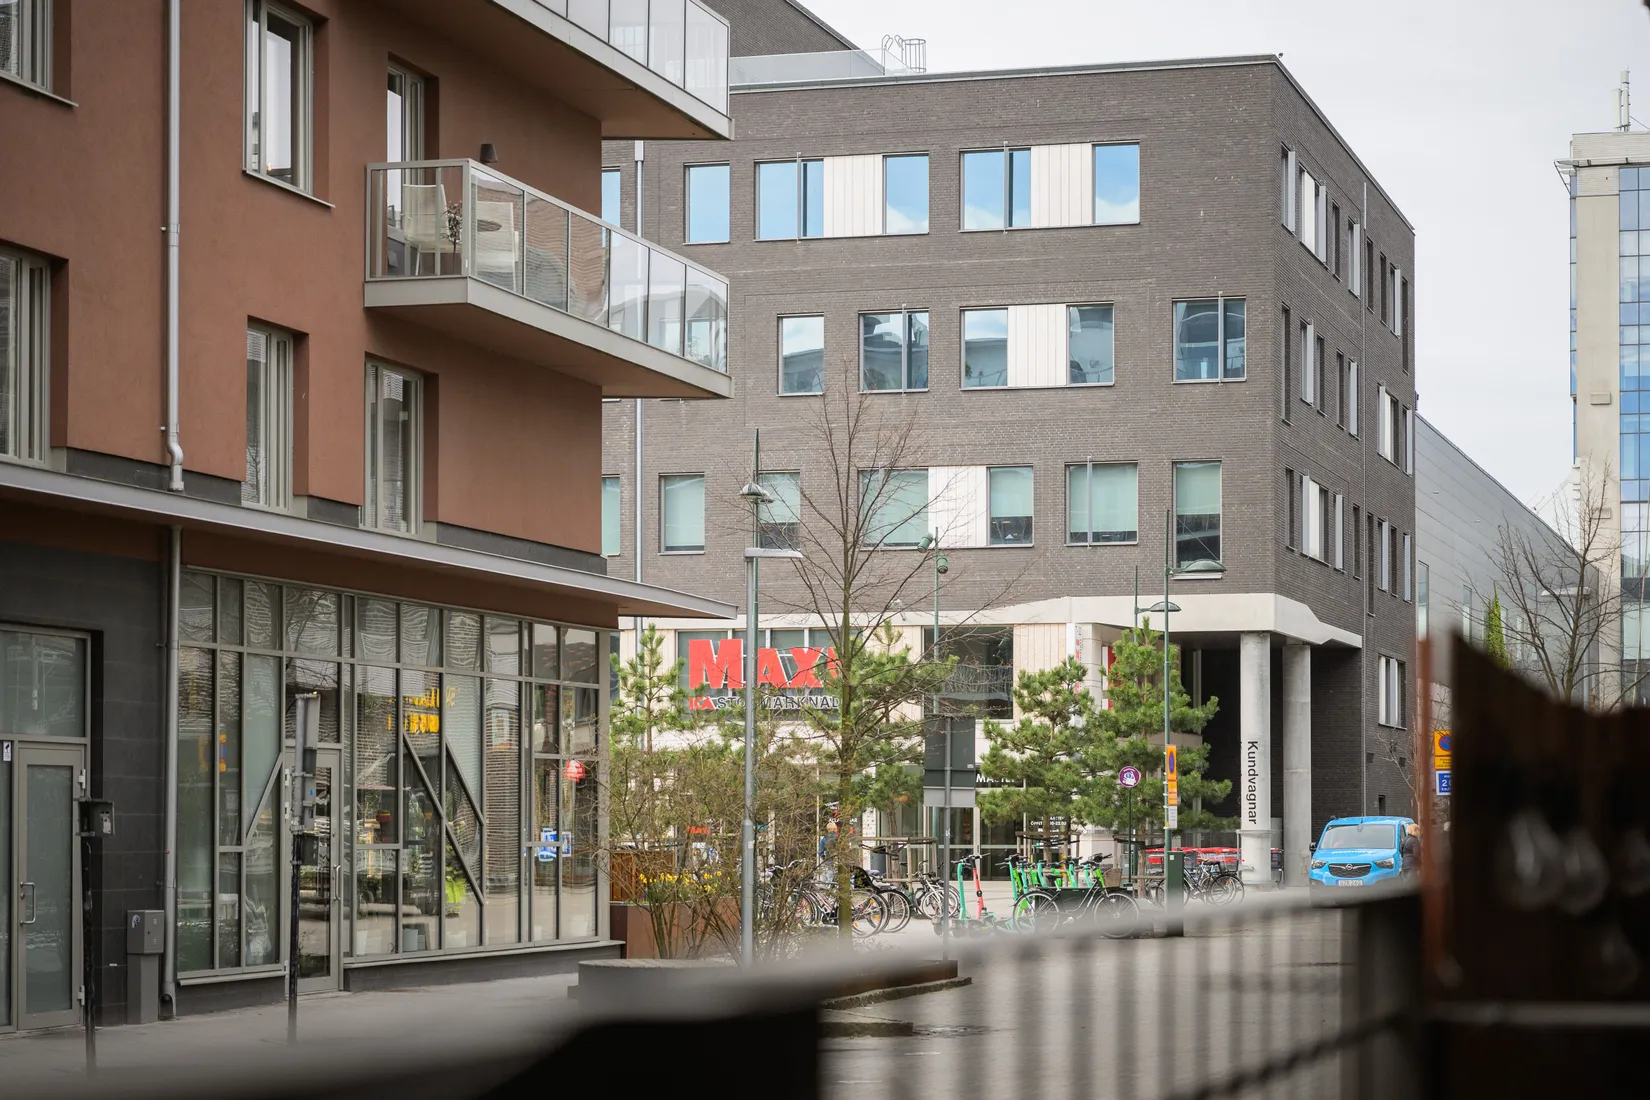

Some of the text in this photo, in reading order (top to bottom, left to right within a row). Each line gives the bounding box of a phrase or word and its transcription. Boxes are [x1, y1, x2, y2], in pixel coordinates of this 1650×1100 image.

[689, 696, 841, 710] ICA STOMARKNAD
[1246, 741, 1259, 825] Kundvagnar
